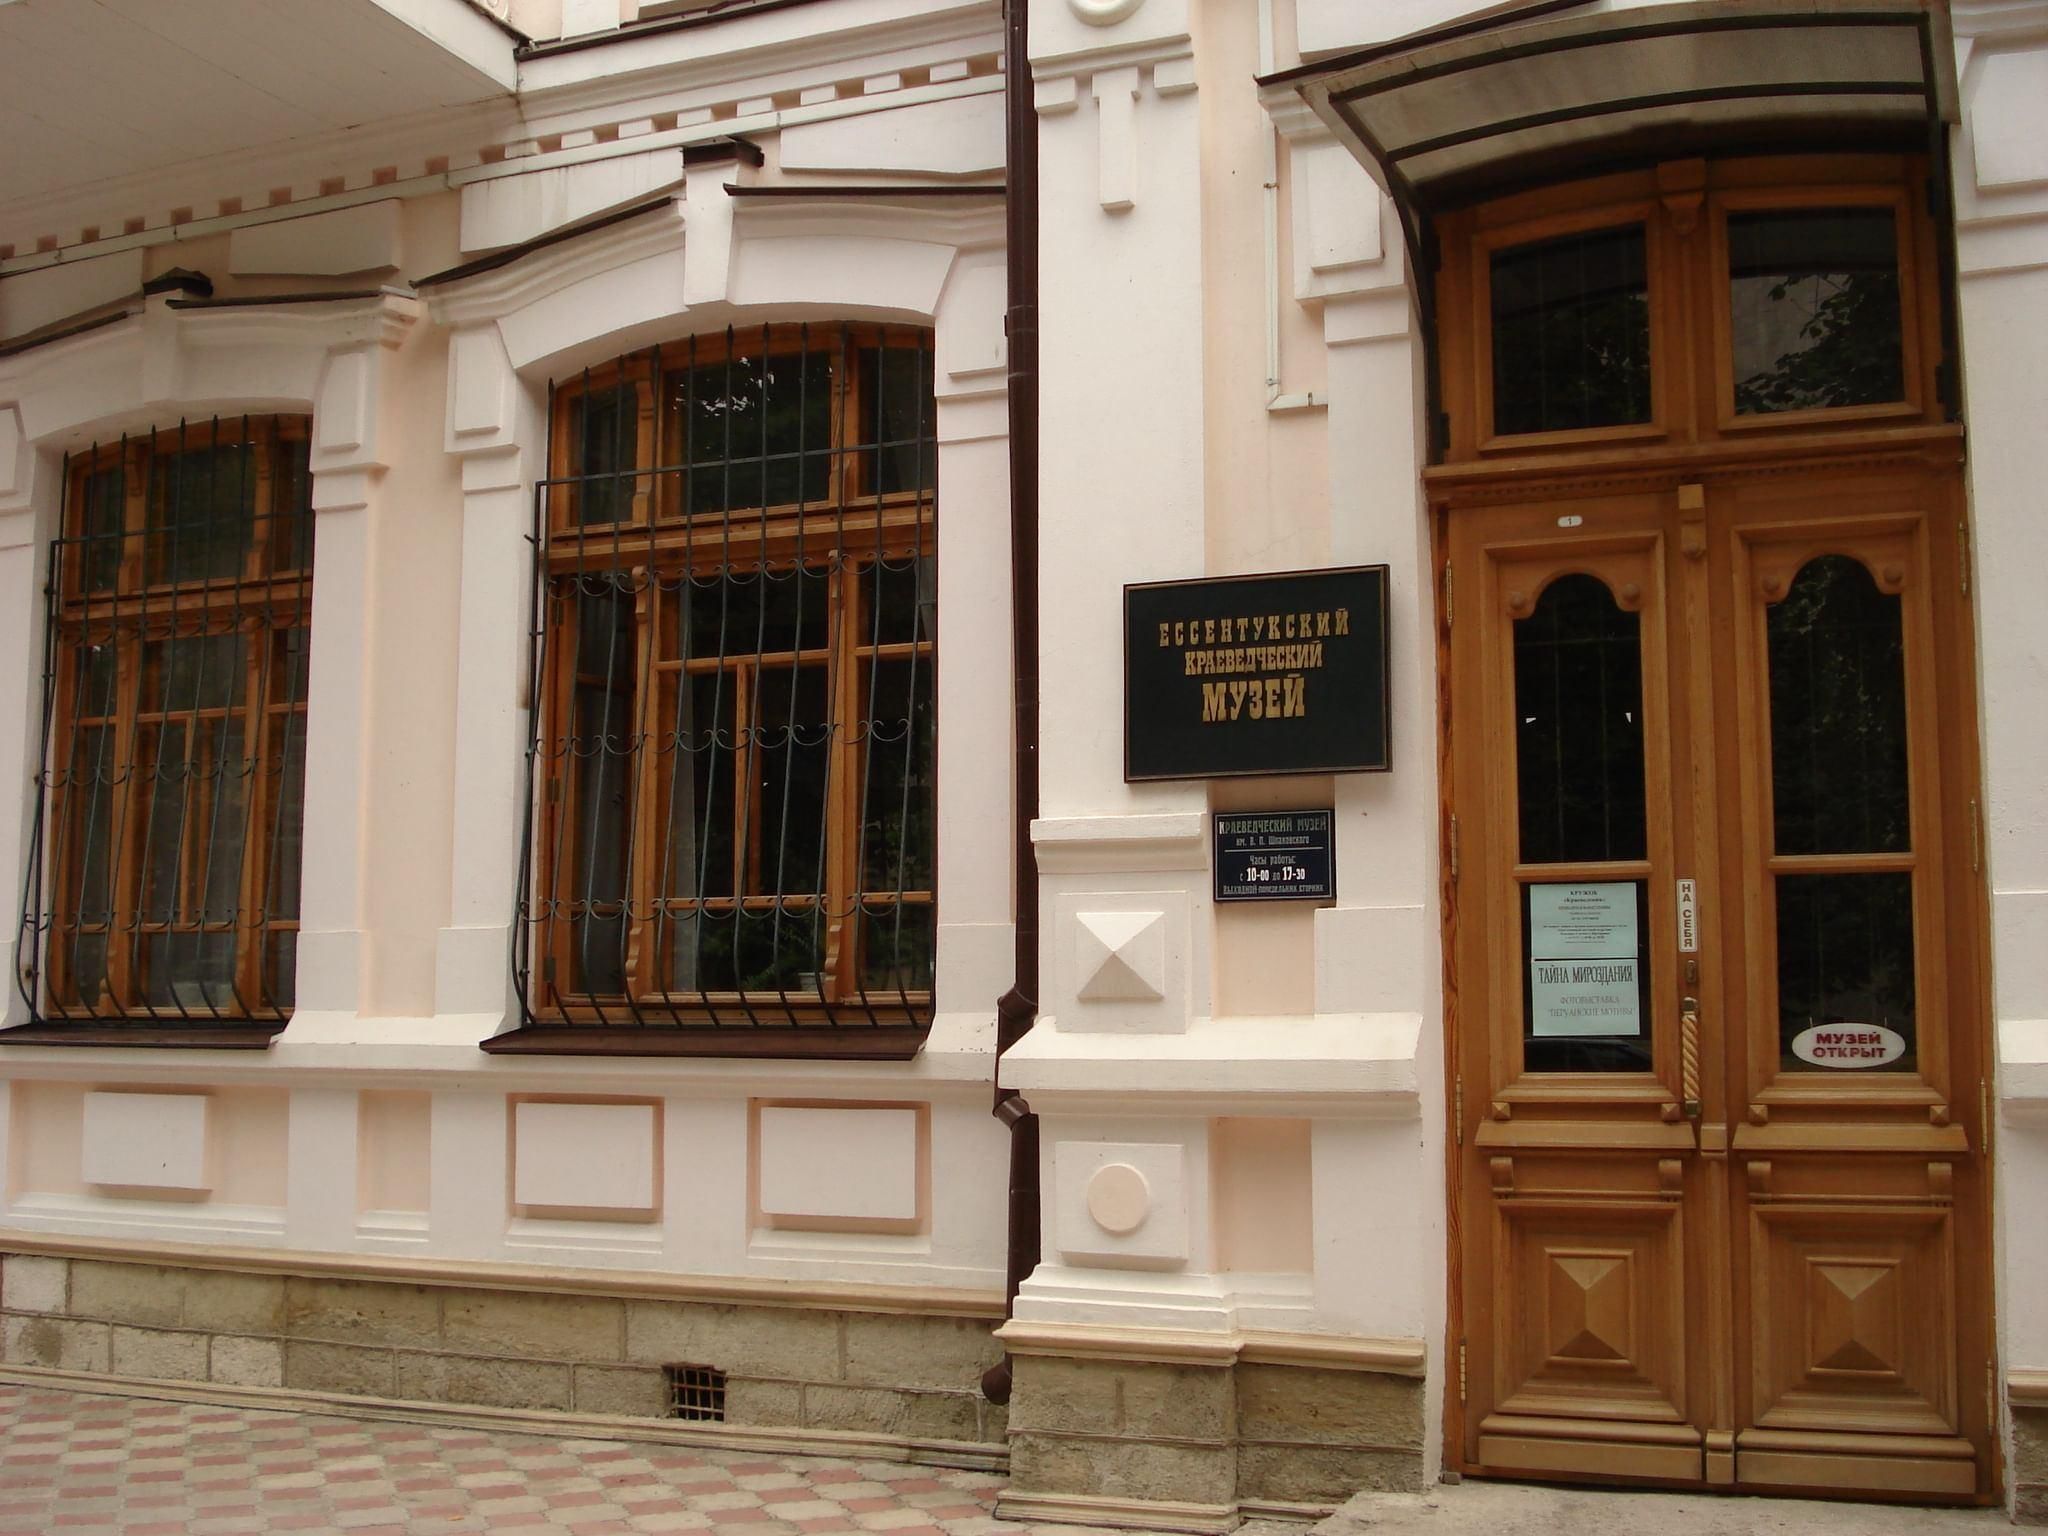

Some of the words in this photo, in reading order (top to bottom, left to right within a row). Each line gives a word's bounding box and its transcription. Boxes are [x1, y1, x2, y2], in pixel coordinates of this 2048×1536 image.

[1159, 607, 1349, 647] ЕССЕНТУКСКИЙ
[1185, 640, 1323, 676] КРАЕВЕДЧЕСКИЙ
[1202, 673, 1305, 722] МУЗЕЙ
[1219, 817, 1292, 834] КРАЕВЕДЧЕСКИЙ
[1297, 816, 1327, 831] МУЗЕЙ
[1250, 856, 1267, 865] Часы
[1246, 867, 1270, 882] 10-00
[1272, 872, 1281, 881] до
[1282, 866, 1306, 881] 17-30
[1682, 883, 1692, 902] НА
[1682, 909, 1693, 948] СЕБЯ
[1538, 964, 1569, 984] ТАЙНА
[1572, 965, 1633, 986] МИРОЗДАНИЯ
[1816, 1031, 1881, 1044] МУЗЕЙ
[1812, 1047, 1887, 1058] ОТКРЫТ
